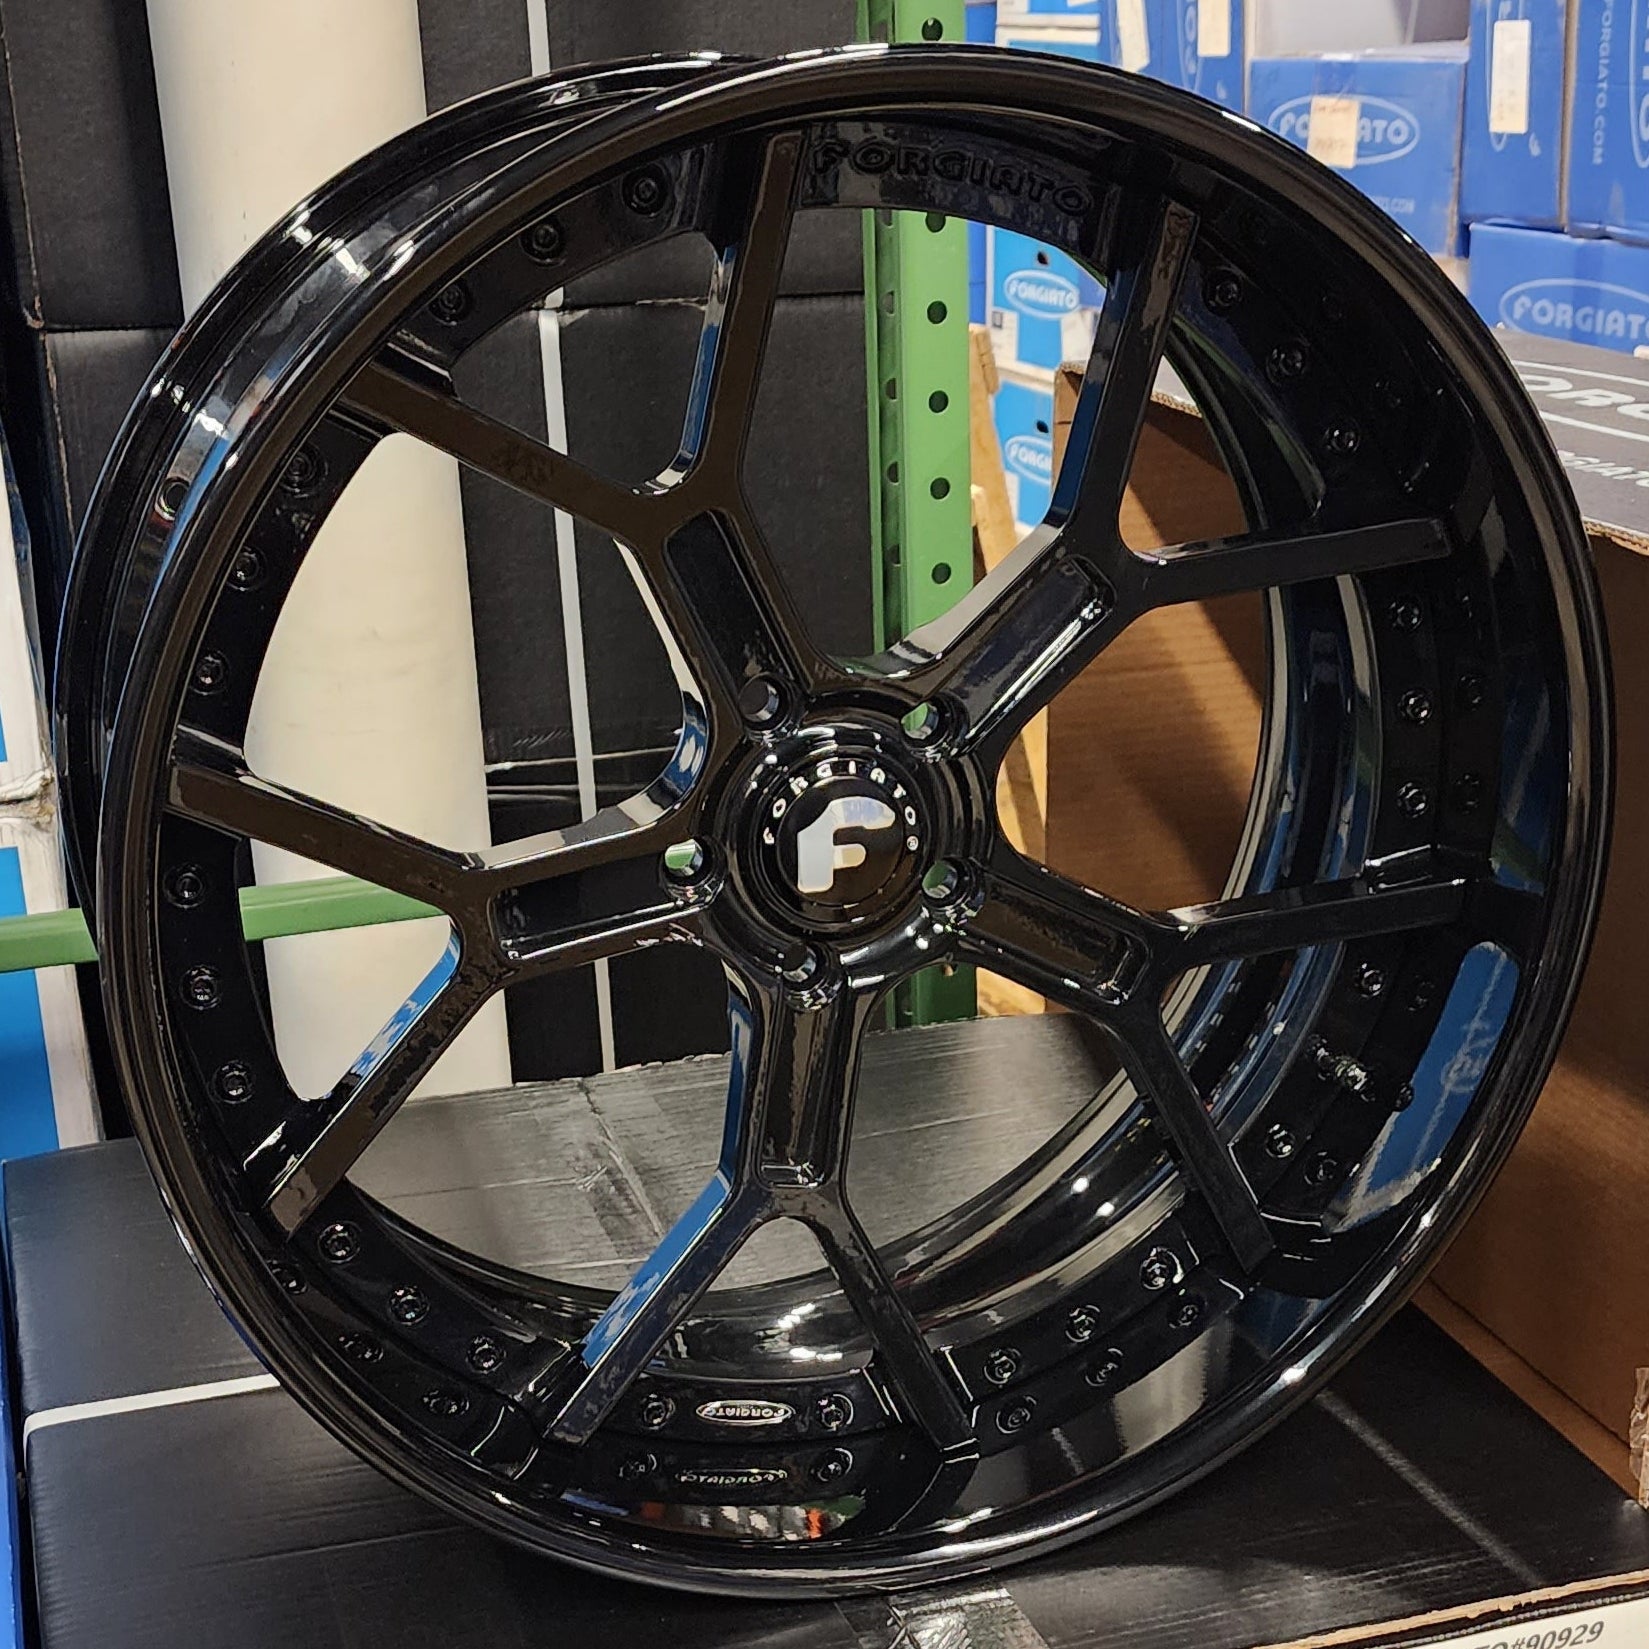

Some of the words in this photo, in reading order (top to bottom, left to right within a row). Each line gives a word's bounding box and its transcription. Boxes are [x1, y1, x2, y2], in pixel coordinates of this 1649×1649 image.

[1279, 111, 1410, 145] FOATO
[813, 141, 1092, 216] FORGIATO
[1513, 295, 1649, 339] FORGIAT
